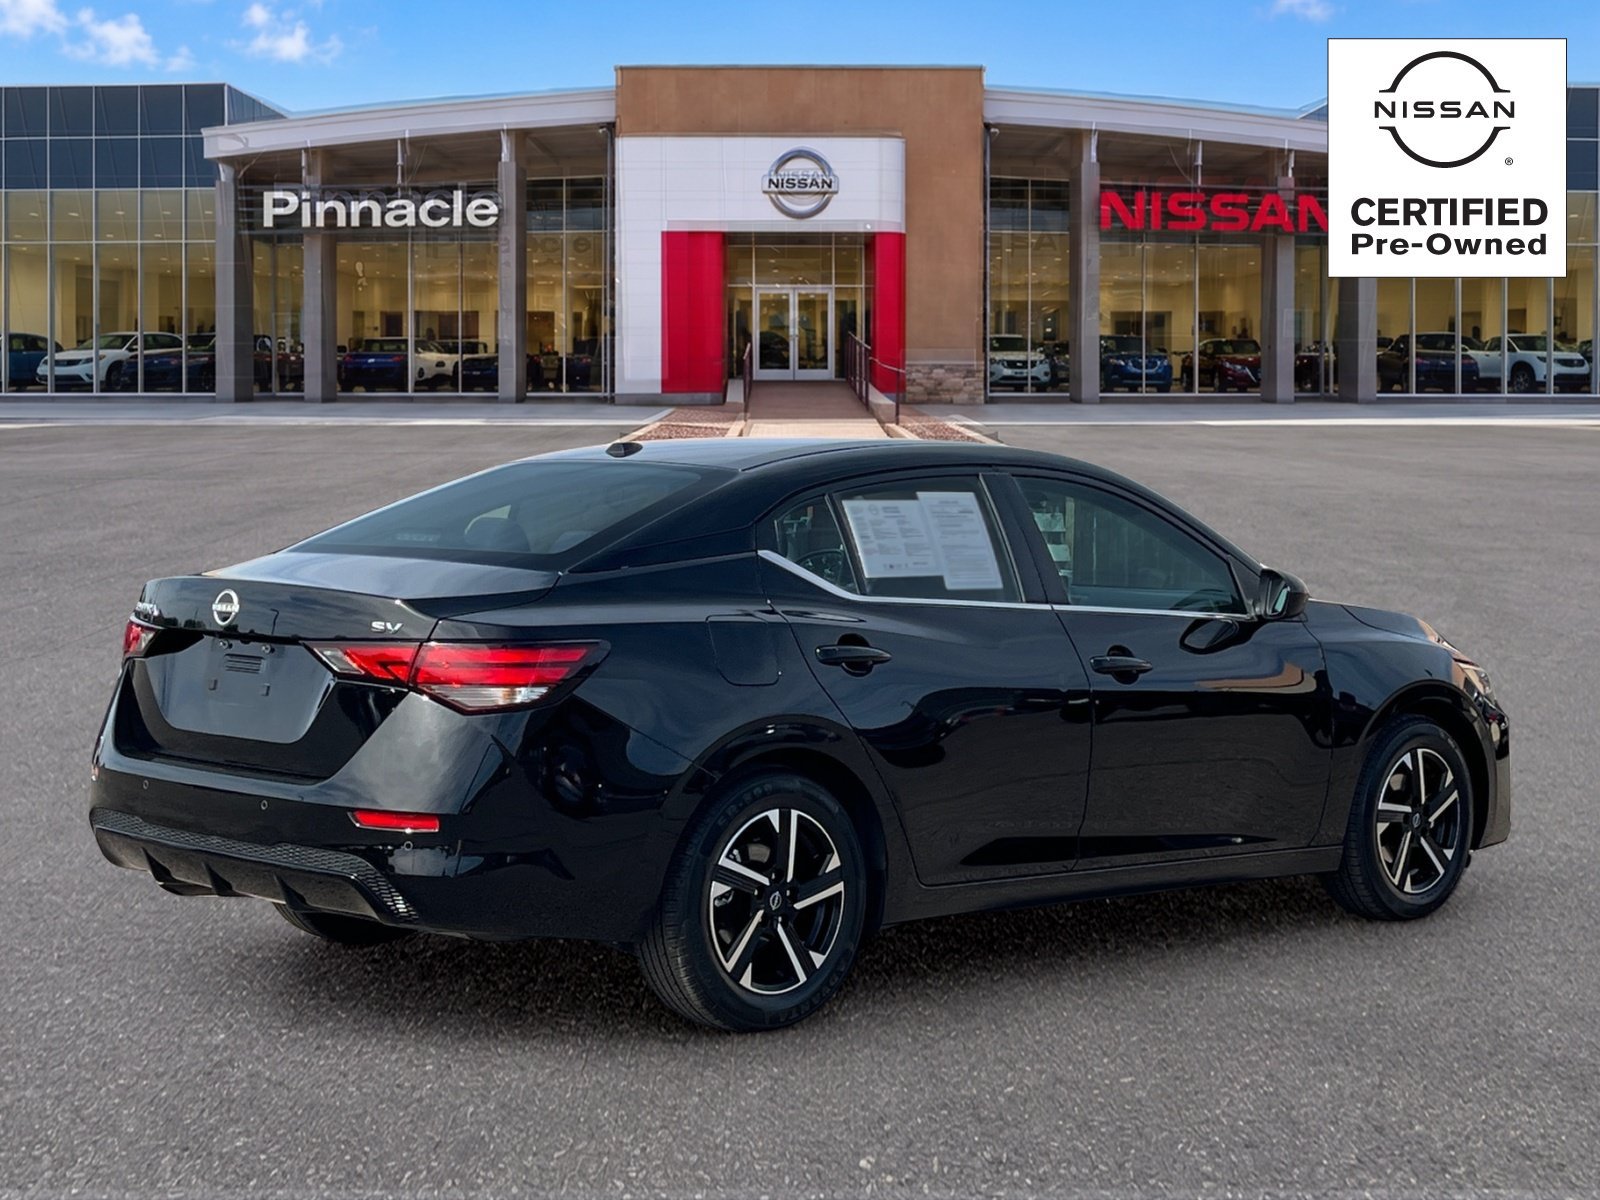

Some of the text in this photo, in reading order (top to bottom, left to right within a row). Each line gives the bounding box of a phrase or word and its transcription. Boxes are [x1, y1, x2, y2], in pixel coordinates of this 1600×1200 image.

[768, 177, 832, 190] NISSAN
[262, 189, 500, 228] Pinnacle
[371, 620, 404, 634] SV
